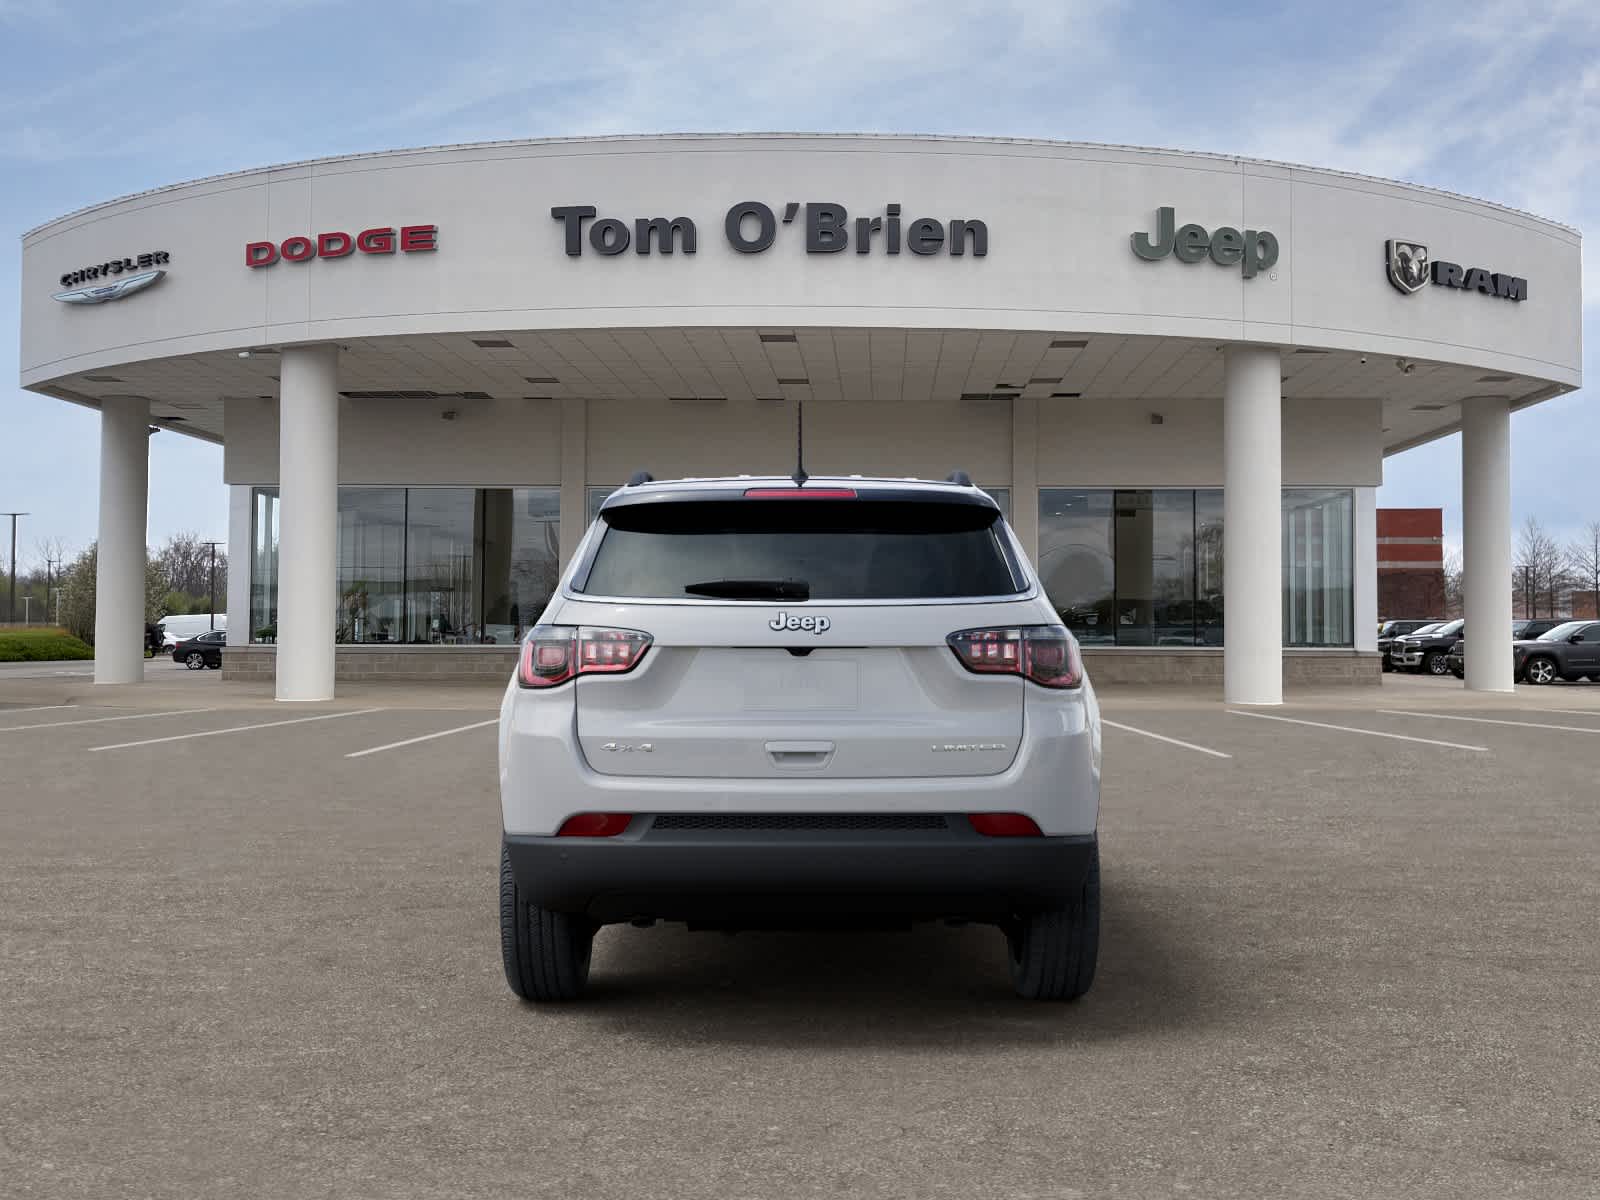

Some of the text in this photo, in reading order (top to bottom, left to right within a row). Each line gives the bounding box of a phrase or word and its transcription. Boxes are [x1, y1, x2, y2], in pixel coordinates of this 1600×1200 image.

[245, 224, 437, 269] DODGE
[551, 201, 988, 256] Tom O'Brien
[1130, 207, 1279, 278] Jeep
[60, 250, 170, 287] CHRYSLER
[1431, 261, 1527, 302] RAM
[769, 611, 831, 635] Jeep
